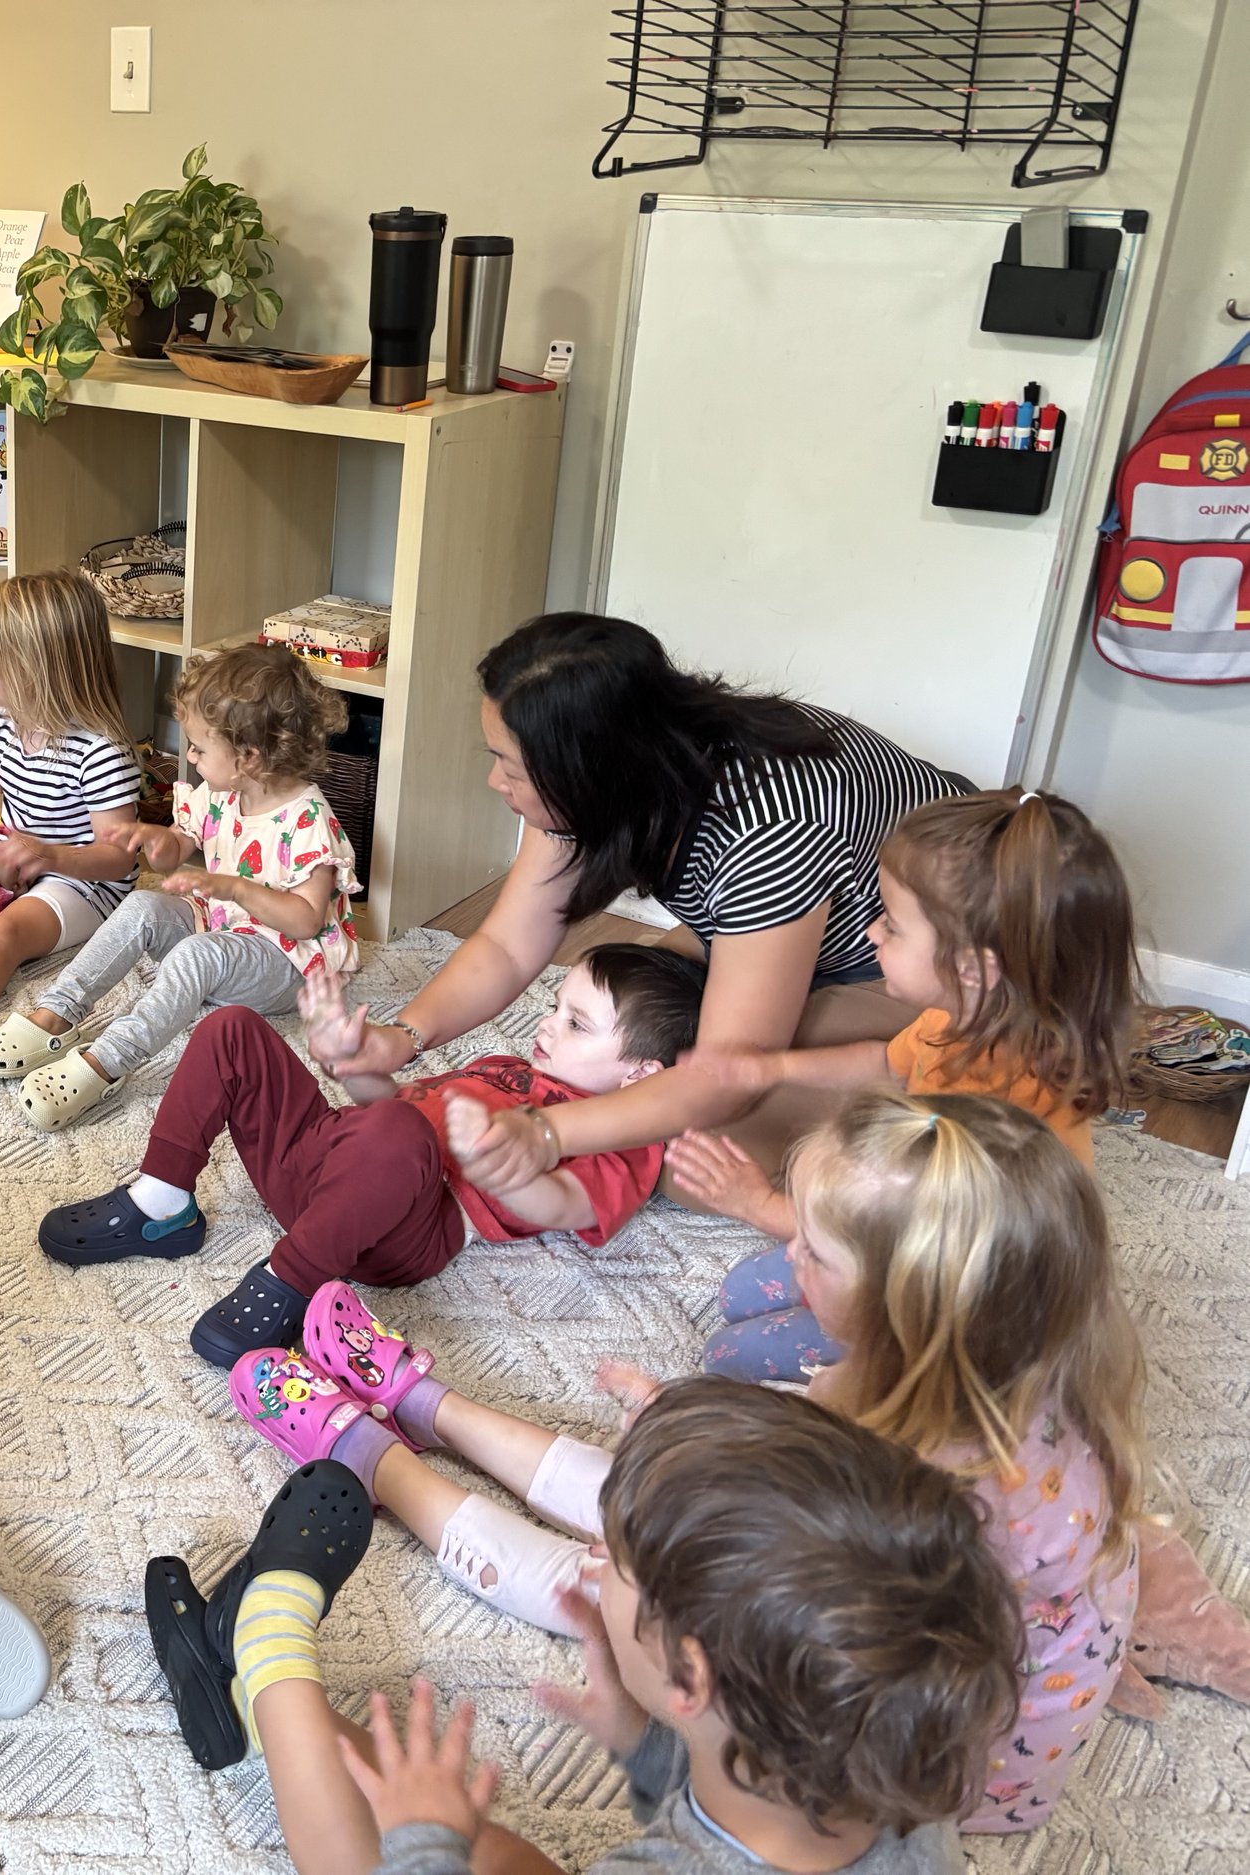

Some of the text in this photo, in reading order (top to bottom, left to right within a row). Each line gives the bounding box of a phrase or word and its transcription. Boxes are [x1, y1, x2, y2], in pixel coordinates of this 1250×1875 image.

[4, 234, 25, 245] Pear
[1214, 453, 1234, 466] FD
[1198, 504, 1250, 515] QUINN
